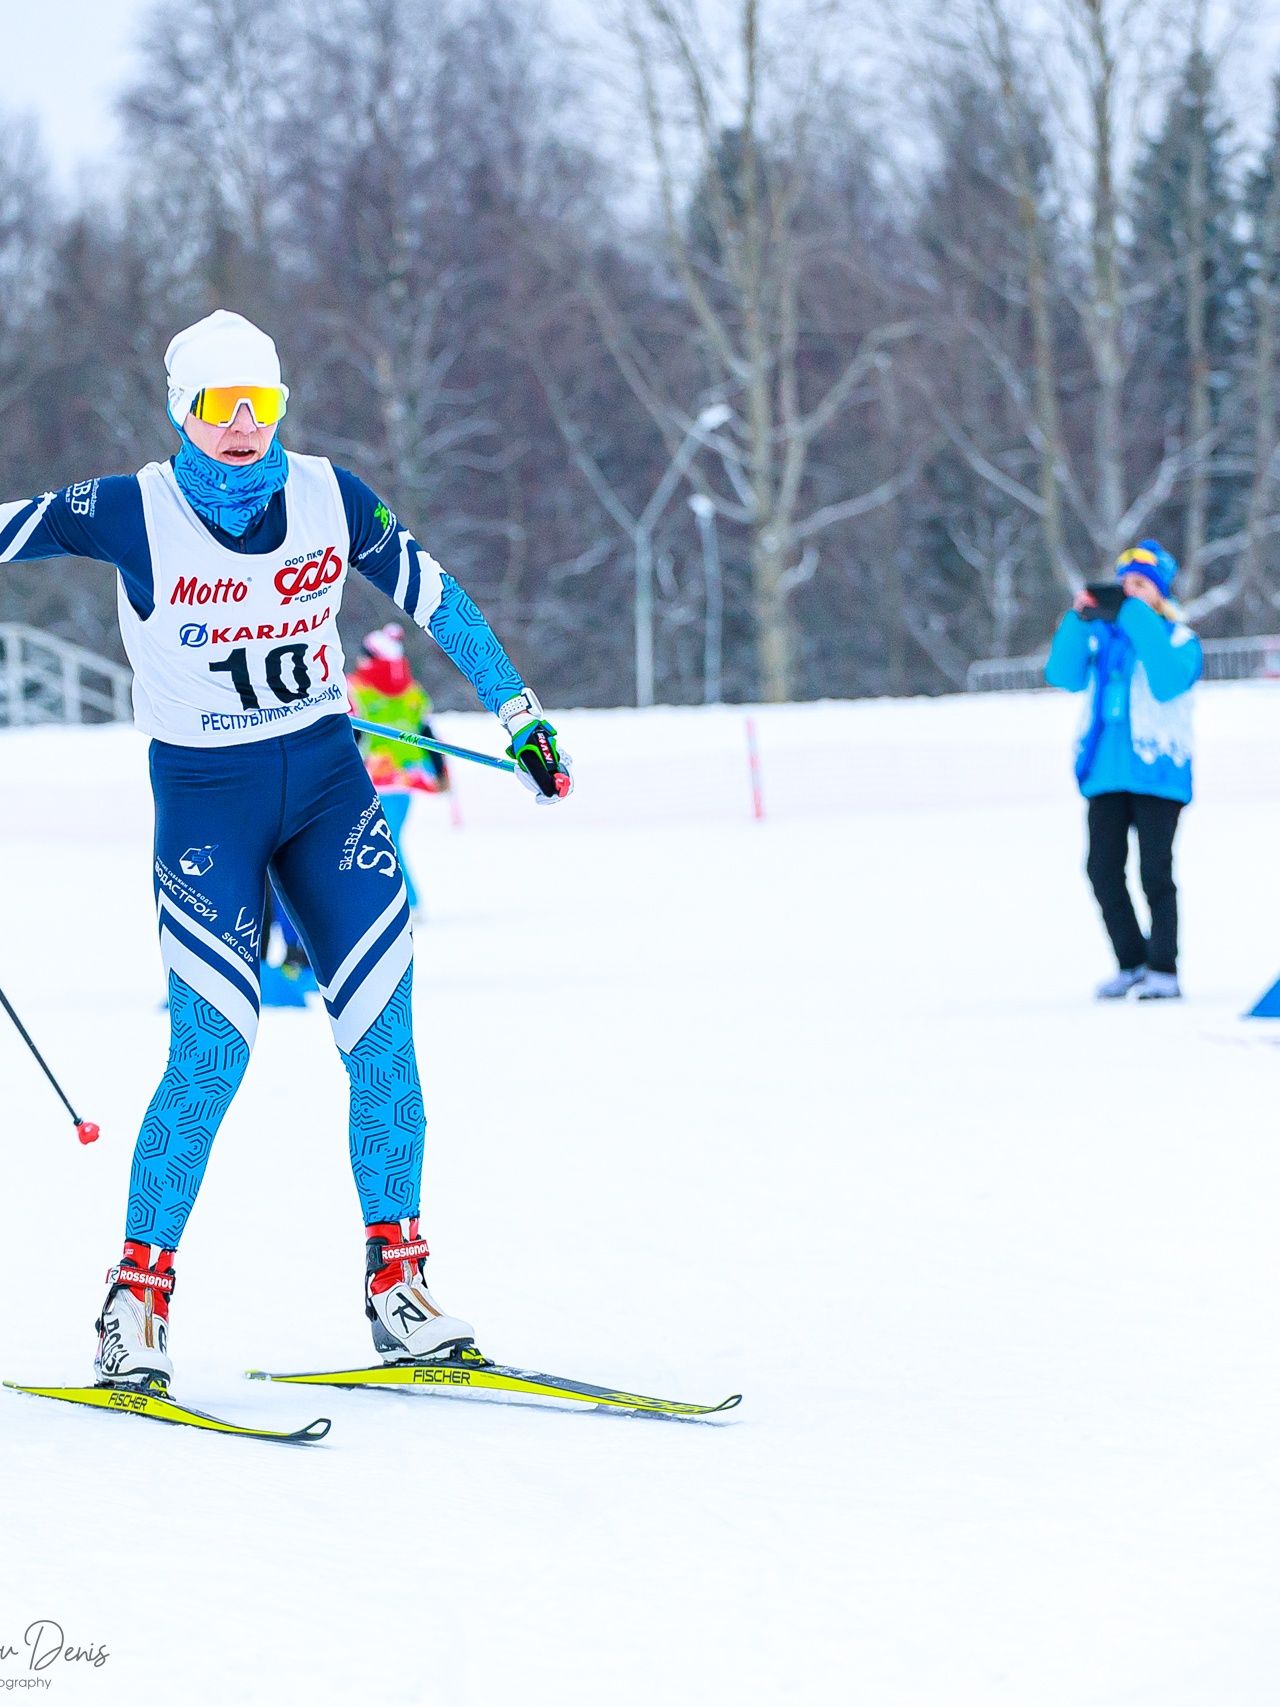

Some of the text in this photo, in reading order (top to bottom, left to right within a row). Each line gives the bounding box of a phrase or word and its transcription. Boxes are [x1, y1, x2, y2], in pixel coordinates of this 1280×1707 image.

[285, 549, 324, 567] ООО ПКФ
[170, 576, 248, 606] Motto
[211, 606, 331, 644] KARJALA
[155, 861, 218, 922] ВОДАСТРОЙ
[221, 932, 254, 963] SKI CUP
[120, 1270, 173, 1289] ROSSIGNOL
[413, 1369, 471, 1384] FISCHER
[108, 1392, 148, 1411] FISCHER
